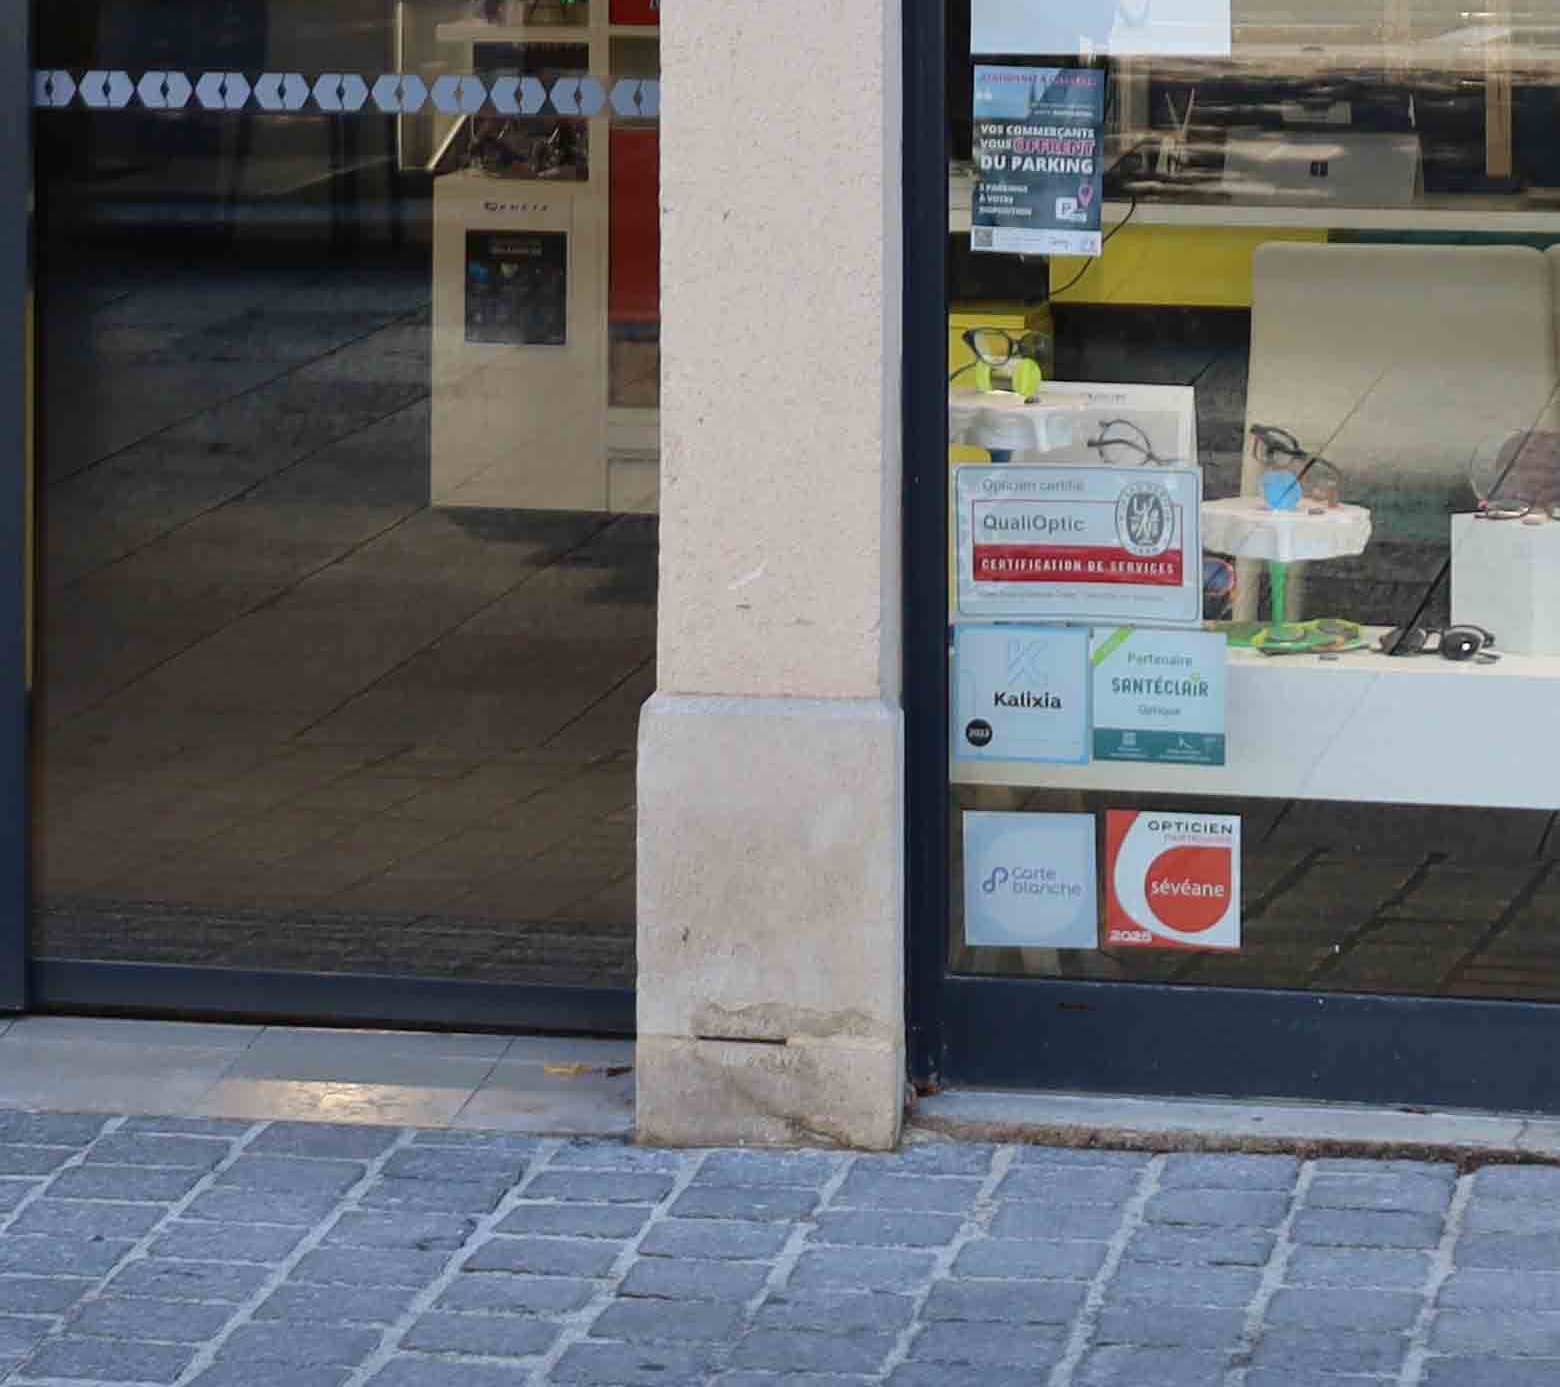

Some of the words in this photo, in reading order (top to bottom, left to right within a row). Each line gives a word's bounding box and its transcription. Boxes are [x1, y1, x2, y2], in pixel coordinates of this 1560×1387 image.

[979, 123, 1005, 135] VOS
[1006, 124, 1096, 140] COMMERÇANTS
[979, 138, 1012, 150] VOUS
[979, 154, 1007, 171] DU
[1011, 155, 1094, 174] PARKING
[982, 478, 1037, 495] Opticien
[983, 513, 1087, 535] QualiOptic
[981, 557, 1080, 572] CERTIFICATION
[1087, 559, 1104, 573] DE
[1110, 561, 1176, 576] SERVICES
[1128, 652, 1193, 667] Partenaire
[993, 690, 1063, 710] Kalixia
[1137, 703, 1182, 719] Optique
[1147, 819, 1233, 835] OPTICIEN
[1011, 880, 1082, 896] blanche
[1151, 879, 1225, 898] sévéane
